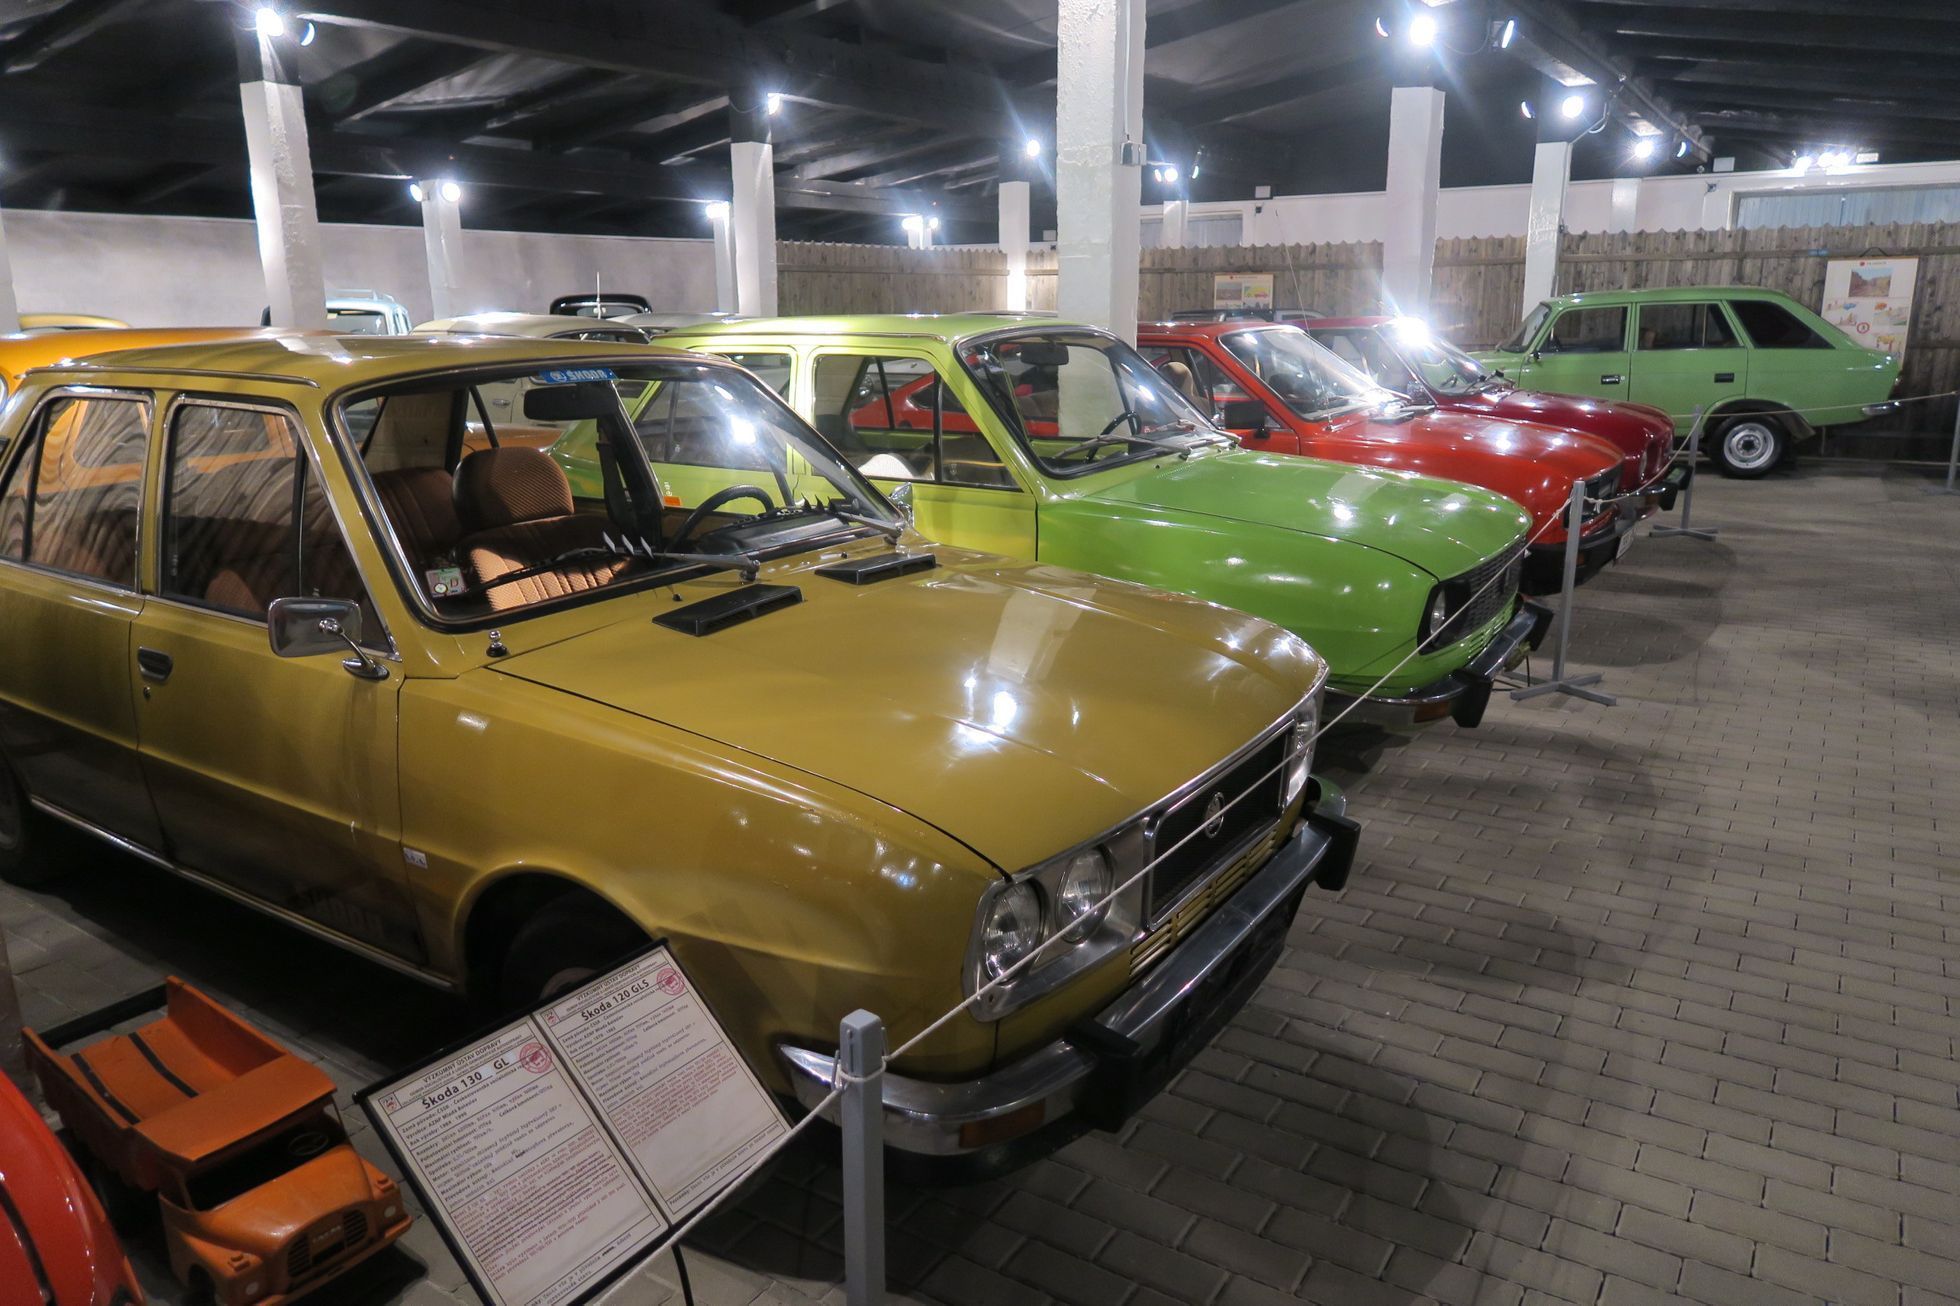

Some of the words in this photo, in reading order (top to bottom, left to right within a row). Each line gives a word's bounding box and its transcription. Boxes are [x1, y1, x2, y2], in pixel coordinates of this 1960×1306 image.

[581, 1000, 613, 1022] Škoda
[612, 989, 631, 1004] 120
[629, 978, 650, 994] GLS
[421, 1086, 461, 1109] Škoda
[460, 1070, 483, 1088] 130
[493, 1056, 510, 1070] GL
